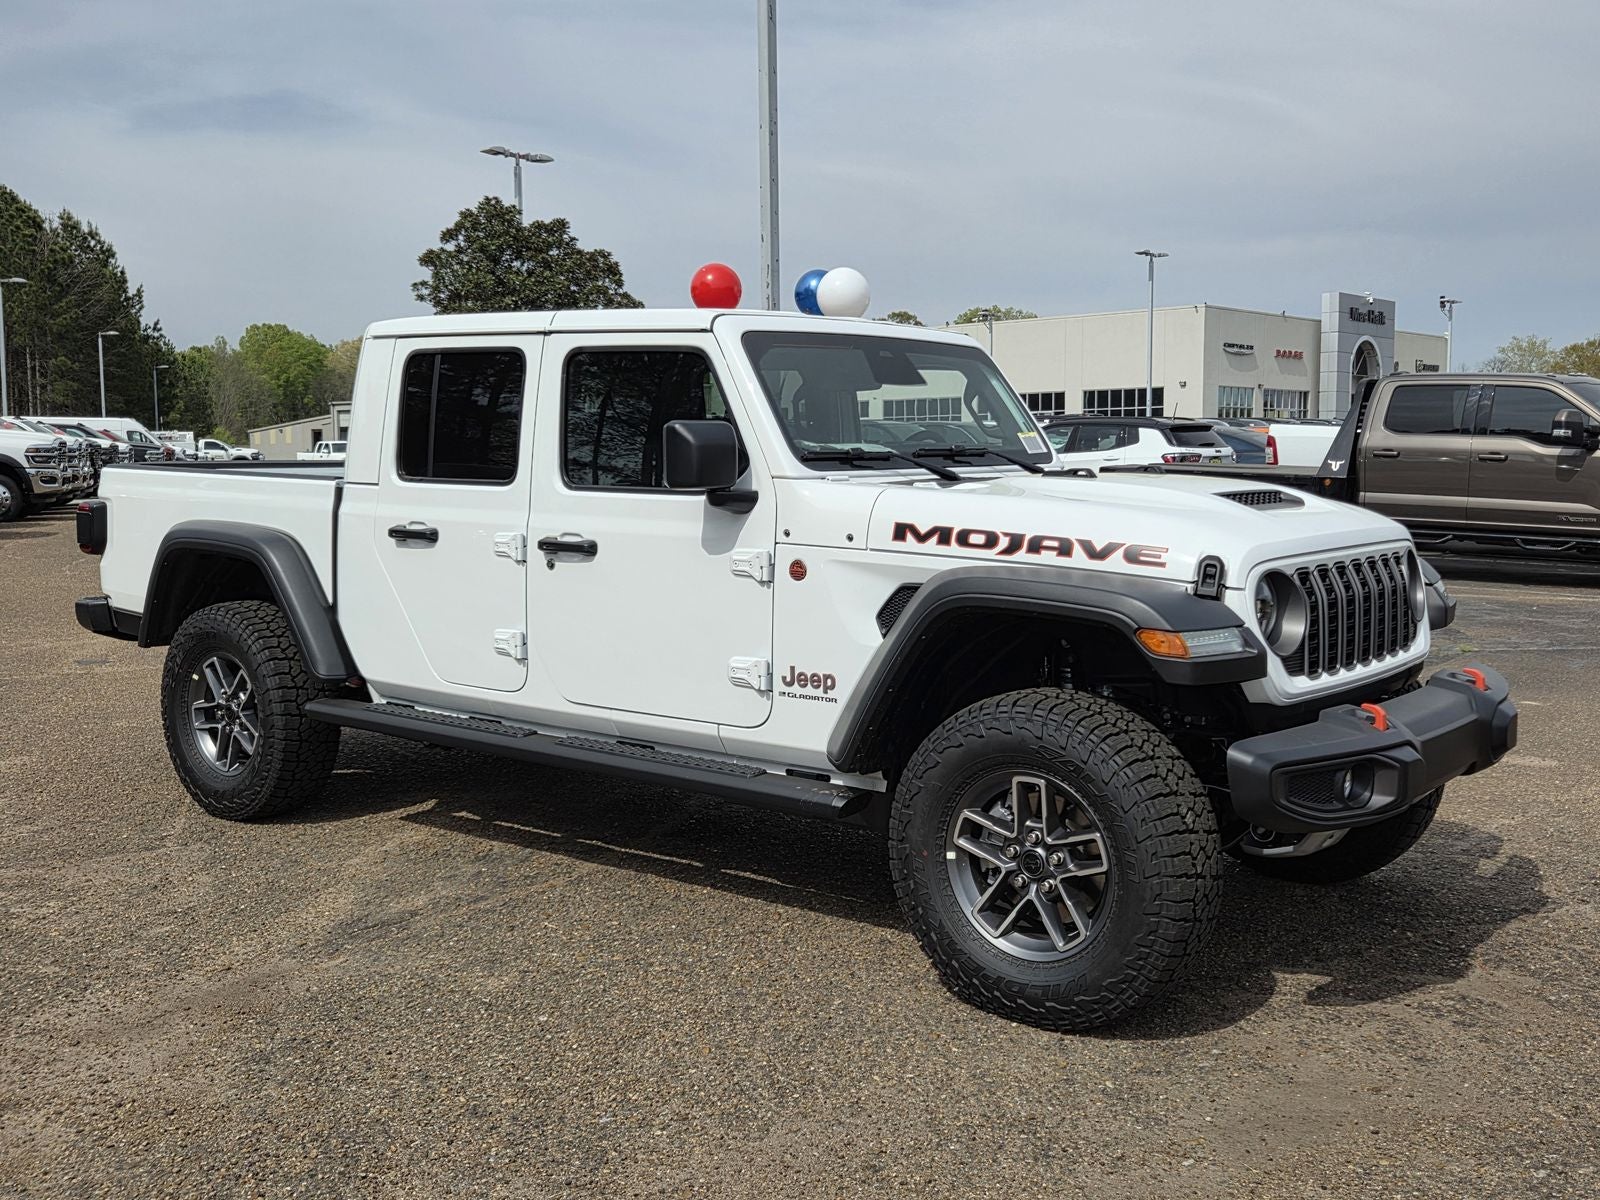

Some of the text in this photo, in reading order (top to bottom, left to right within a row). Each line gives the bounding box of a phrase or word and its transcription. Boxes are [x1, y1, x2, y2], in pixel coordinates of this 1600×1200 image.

[1275, 349, 1304, 360] DODGE
[892, 521, 1169, 569] MOJAVE
[781, 665, 836, 694] Jeep
[787, 691, 838, 703] GLADIATOR
